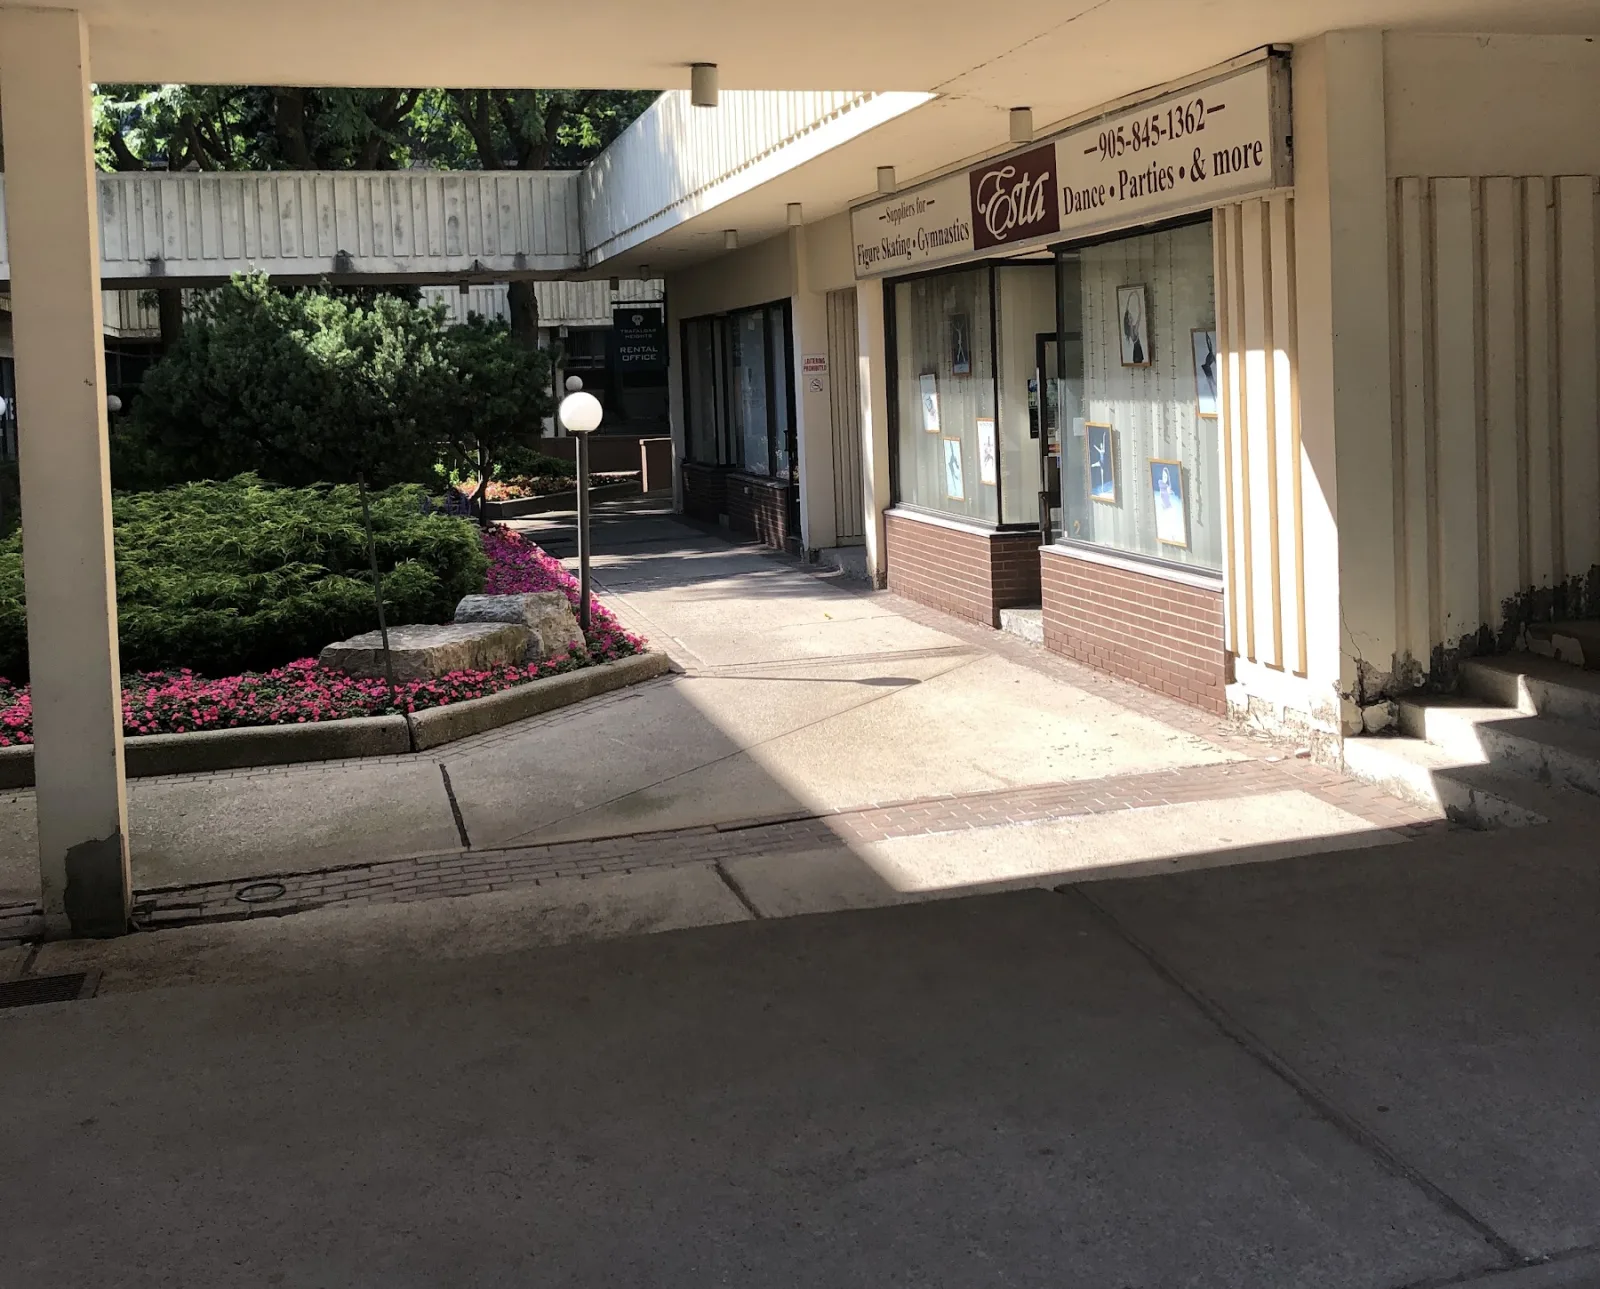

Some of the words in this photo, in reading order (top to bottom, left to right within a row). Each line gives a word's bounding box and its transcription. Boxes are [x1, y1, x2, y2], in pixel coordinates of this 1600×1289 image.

[976, 165, 1050, 241] Esta
[1063, 184, 1106, 216] Dance
[1118, 160, 1175, 201] Parties
[1190, 147, 1207, 183] &
[1212, 139, 1263, 177] more
[857, 243, 880, 270] Figure
[881, 234, 912, 261] Skating
[917, 217, 970, 256] Gymnastics
